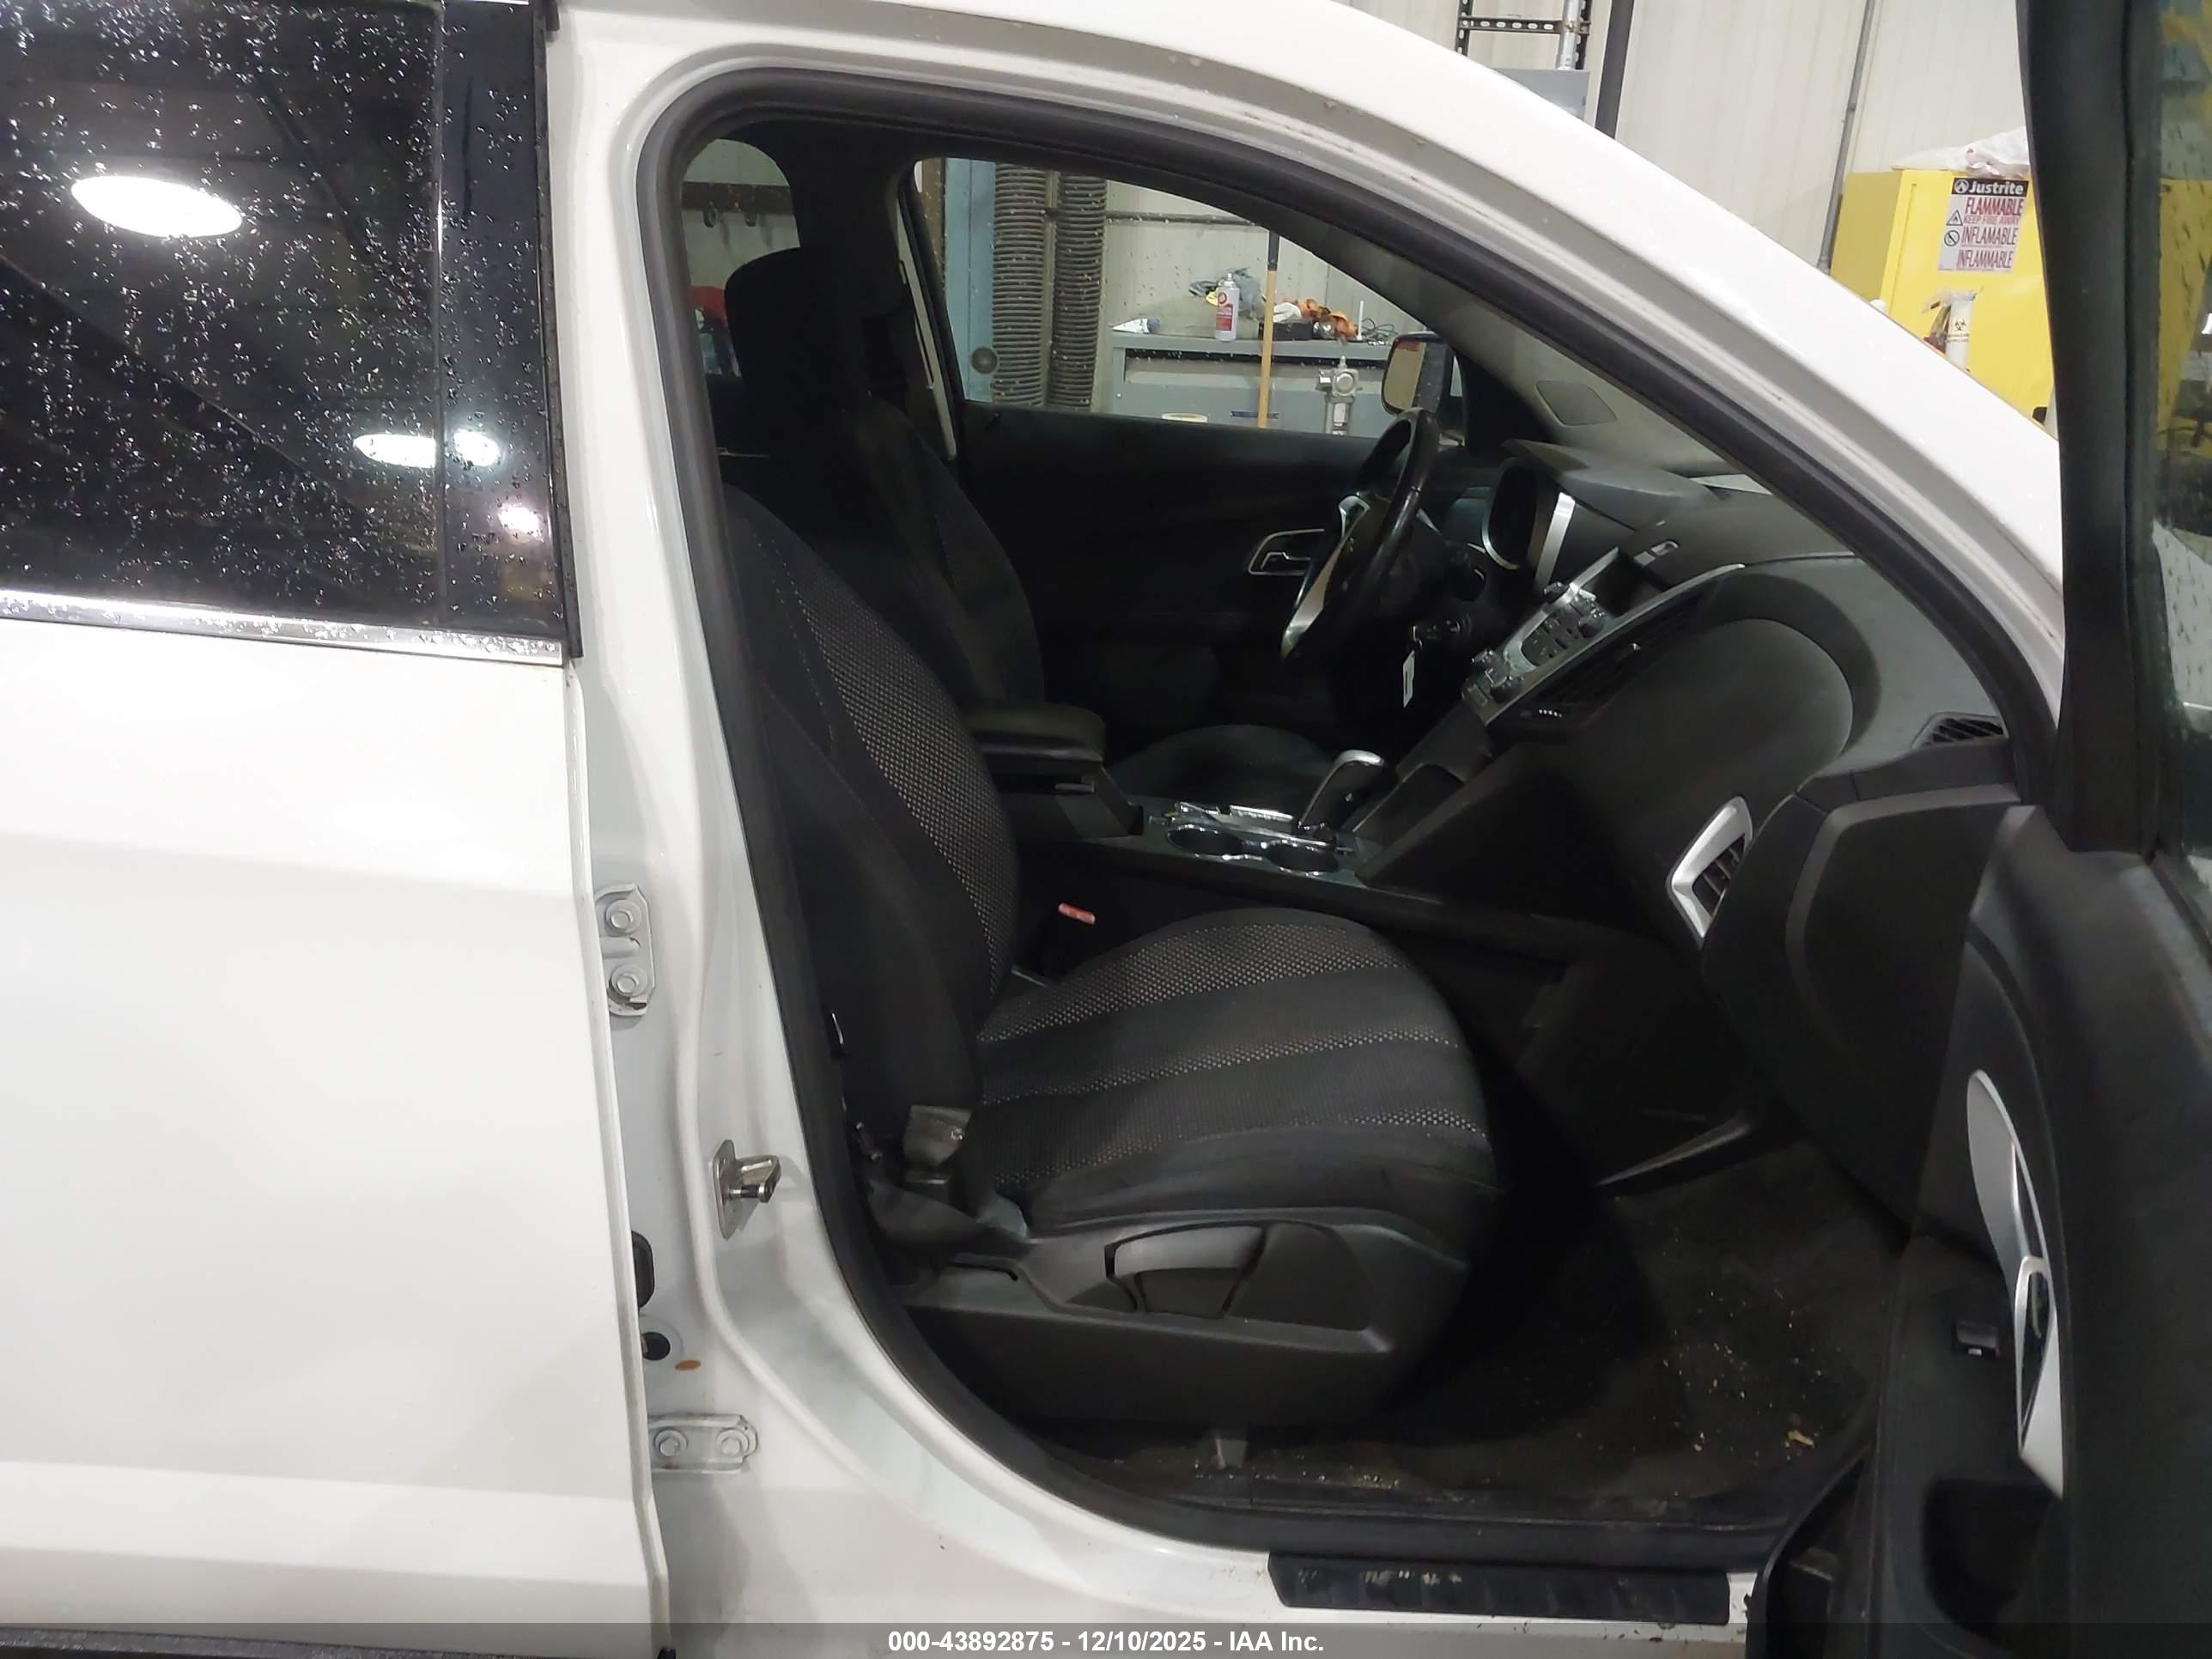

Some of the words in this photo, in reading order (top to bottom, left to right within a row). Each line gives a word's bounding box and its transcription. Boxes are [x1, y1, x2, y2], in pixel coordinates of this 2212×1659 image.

[1969, 180, 2024, 195] Justrite
[1965, 197, 2024, 216] FLAMMABLE
[1964, 215, 1981, 224] KEEP
[1962, 226, 2019, 245] INFLAMABLE
[1957, 249, 2014, 268] INFLAMMABLE
